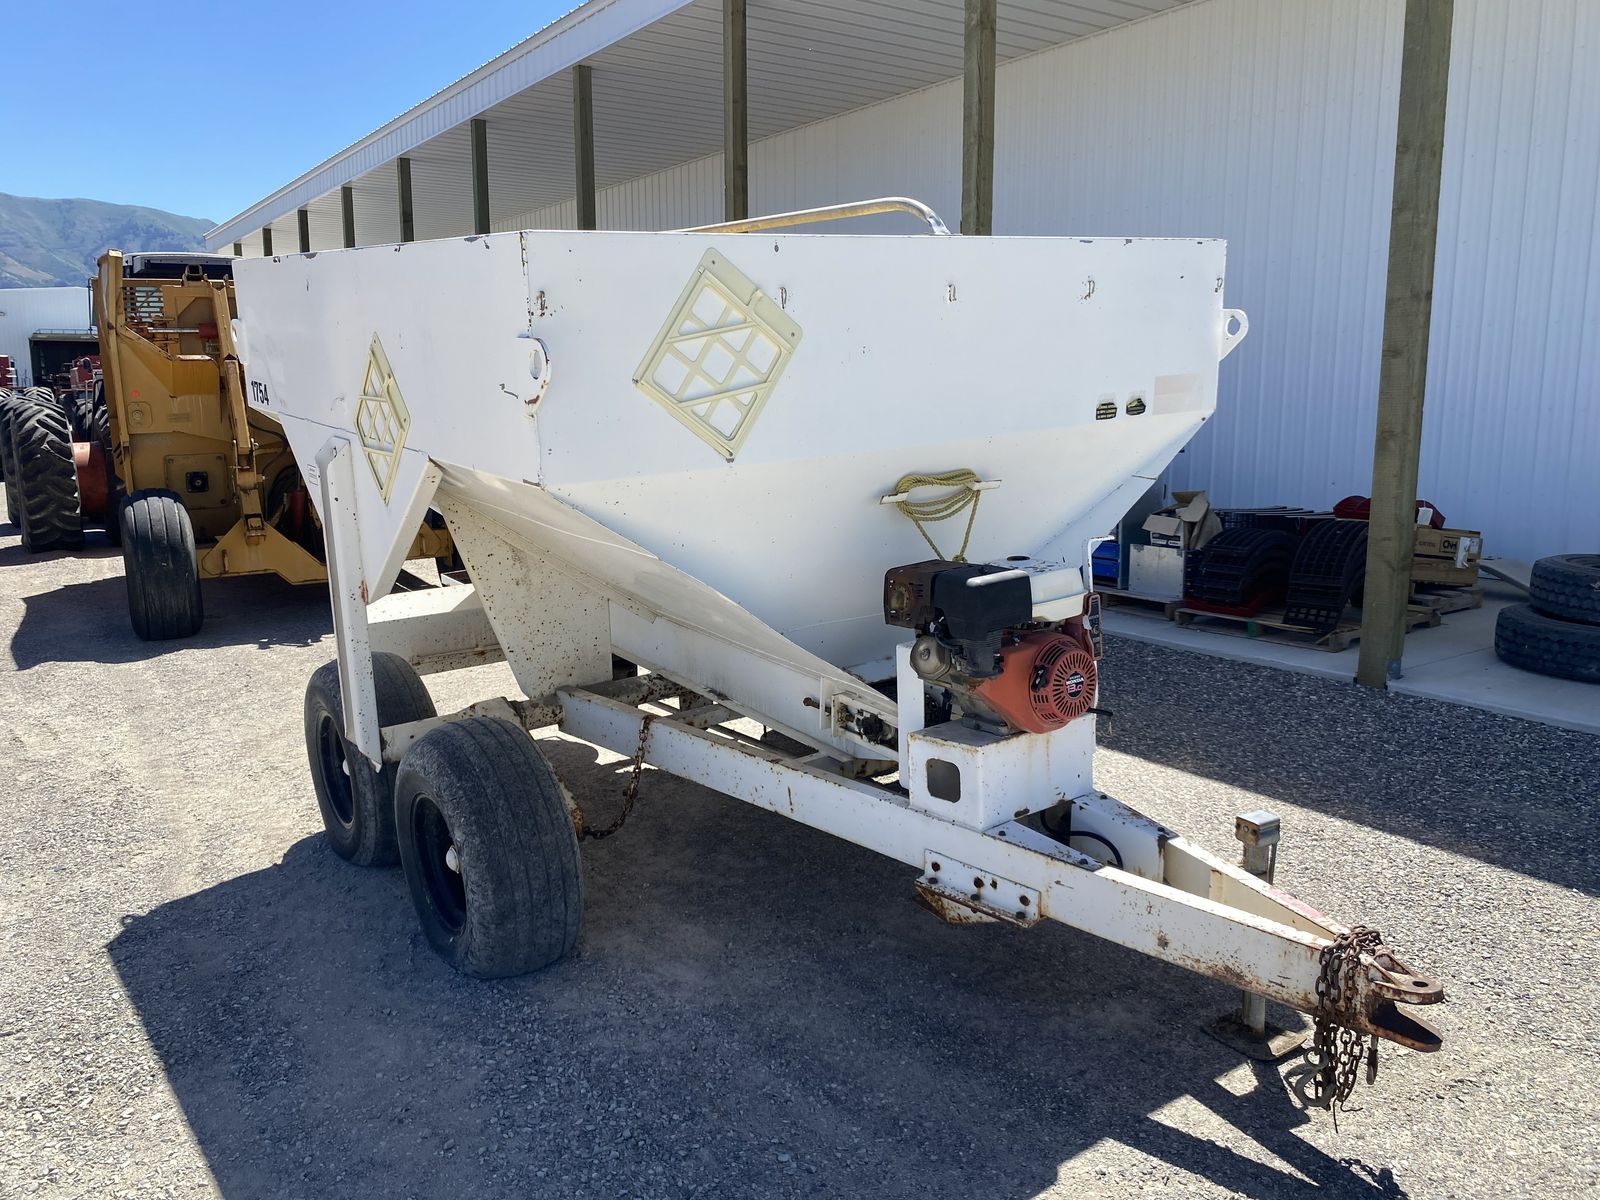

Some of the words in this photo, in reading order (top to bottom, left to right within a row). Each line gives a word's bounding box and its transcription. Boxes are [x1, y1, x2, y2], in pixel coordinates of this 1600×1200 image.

[251, 381, 269, 405] 1754
[1065, 677, 1084, 685] HONDA
[1067, 684, 1083, 693] 13.0
